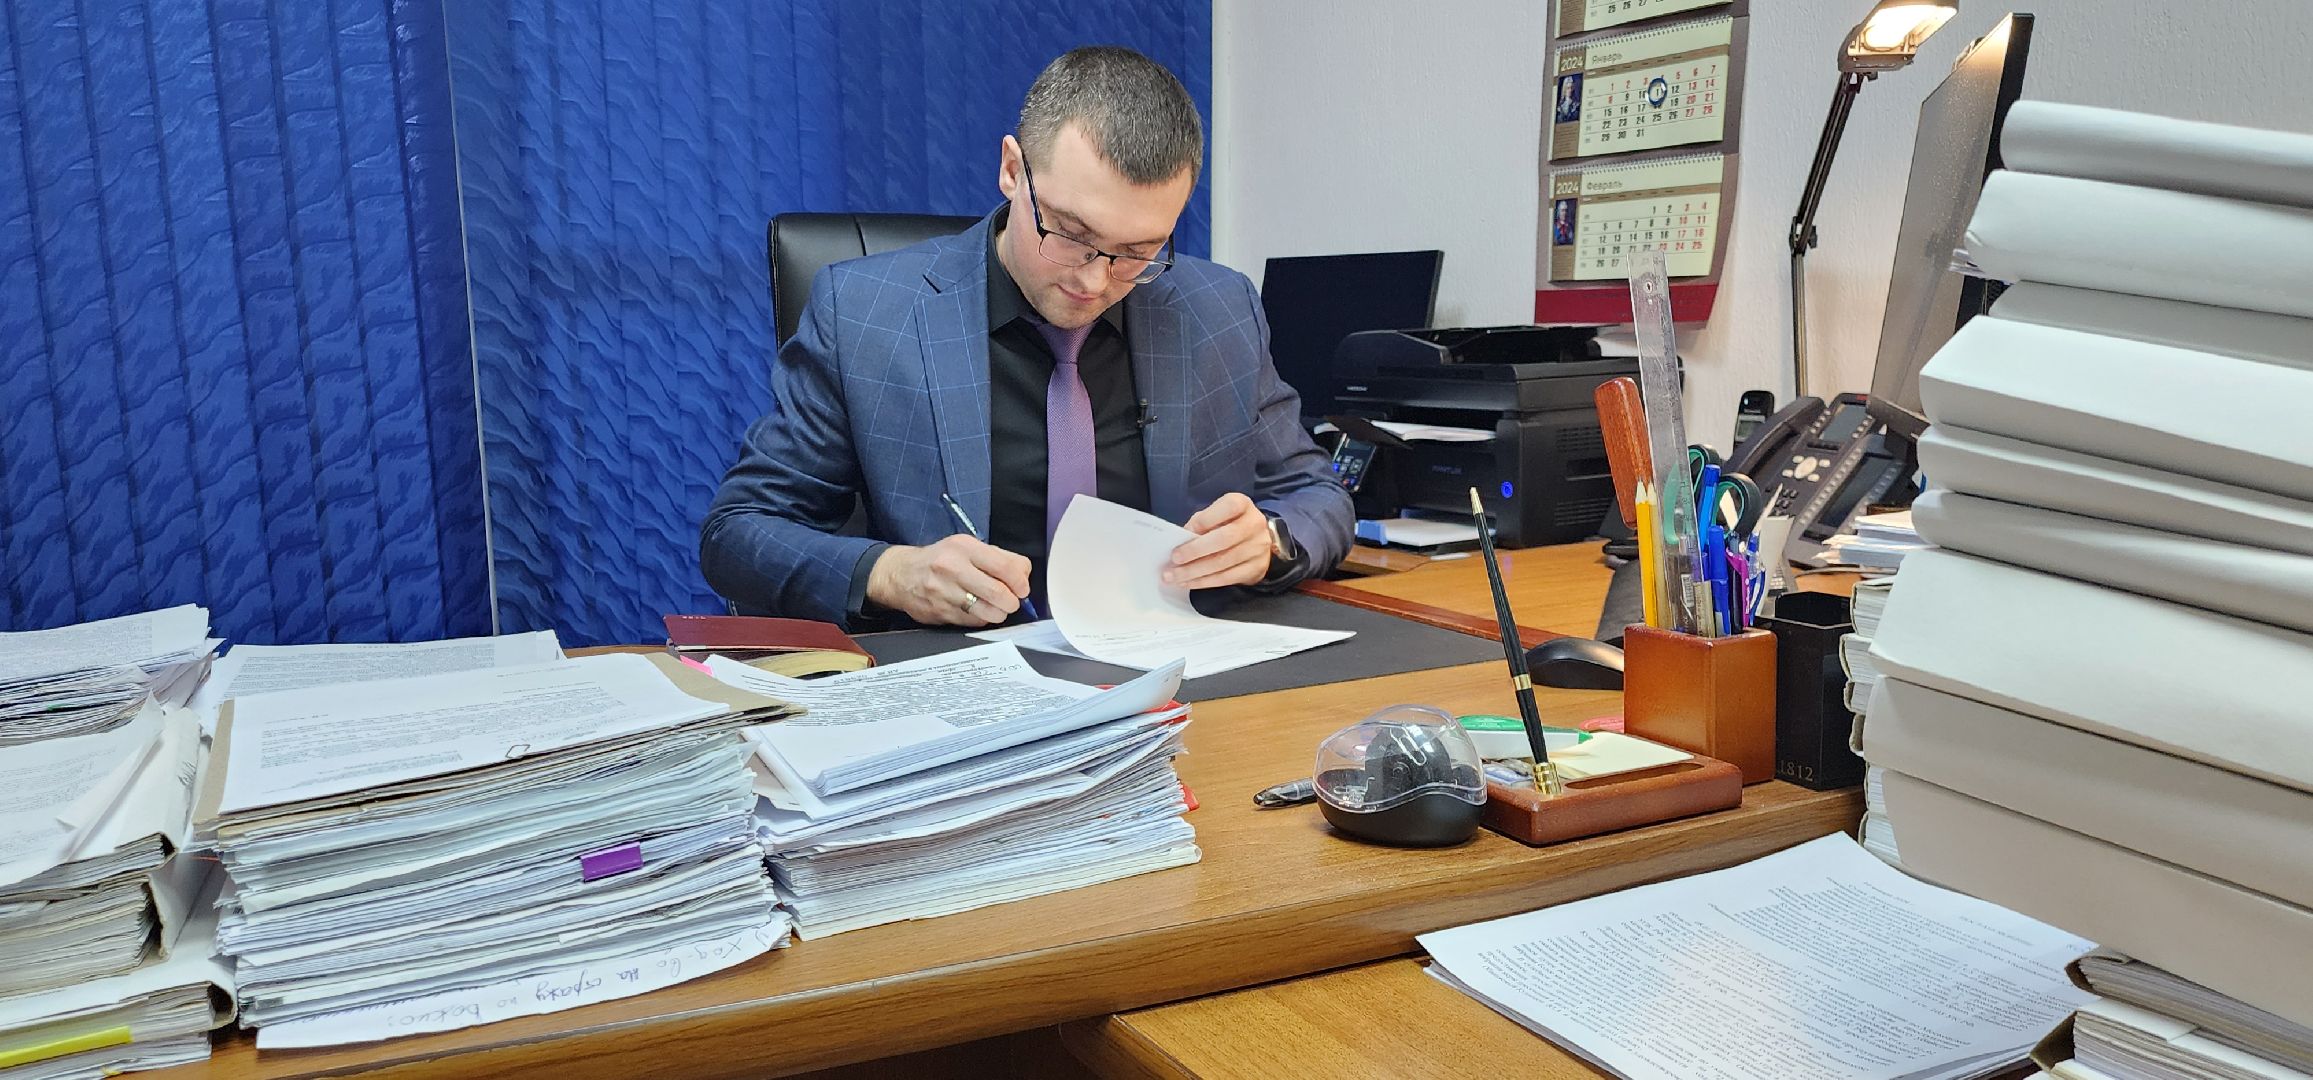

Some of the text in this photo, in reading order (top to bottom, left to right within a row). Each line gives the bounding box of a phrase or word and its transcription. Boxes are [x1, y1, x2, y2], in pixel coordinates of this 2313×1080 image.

[1561, 56, 1583, 71] 2024
[1592, 52, 1622, 65] Январь
[1602, 121, 1611, 129] 22
[1636, 116, 1645, 124] 24
[1653, 114, 1661, 122] 25
[1686, 108, 1694, 118] 27
[1617, 131, 1626, 139] 30
[1636, 129, 1644, 137] 31
[1556, 182, 1579, 195] 2024
[1587, 180, 1623, 190] Февраль
[1780, 760, 1814, 782] 1812
[616, 967, 639, 983] на
